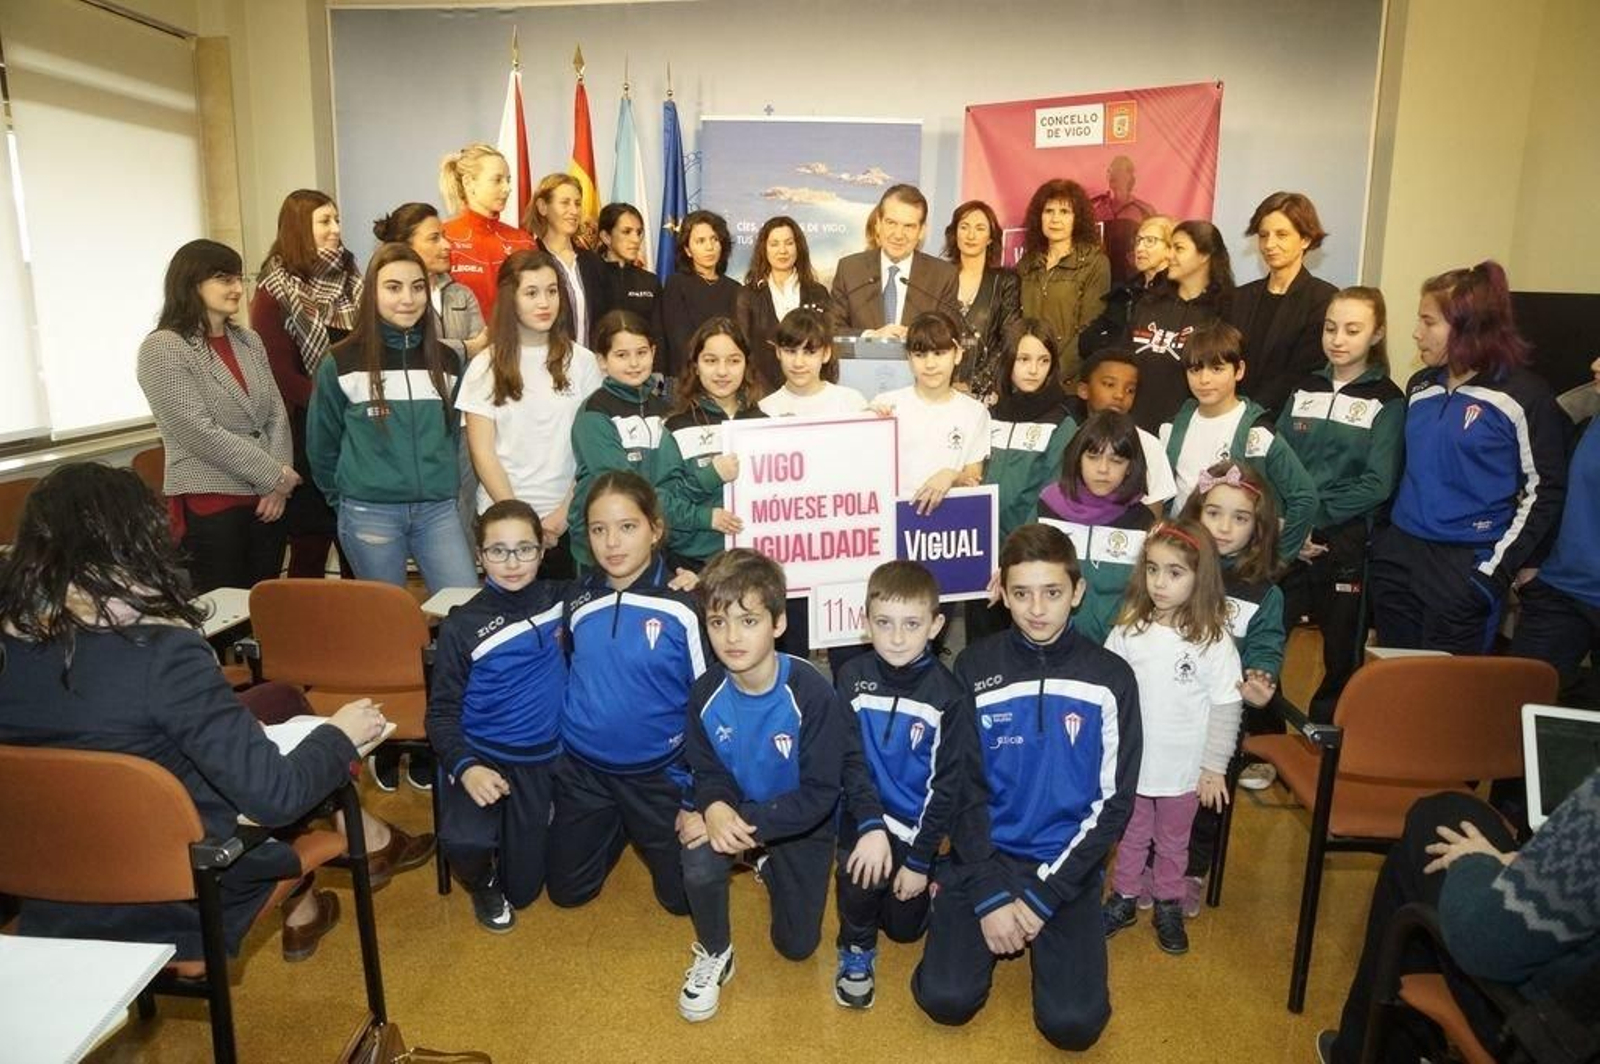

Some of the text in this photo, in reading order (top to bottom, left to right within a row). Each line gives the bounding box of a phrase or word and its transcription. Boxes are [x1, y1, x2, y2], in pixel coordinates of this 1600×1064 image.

[1040, 112, 1099, 127] CONCELLO
[1047, 126, 1092, 138] DE VIGO
[751, 451, 804, 484] VIGO
[752, 491, 879, 523] MÓVESE POLA
[753, 527, 881, 563] IGUALDADE
